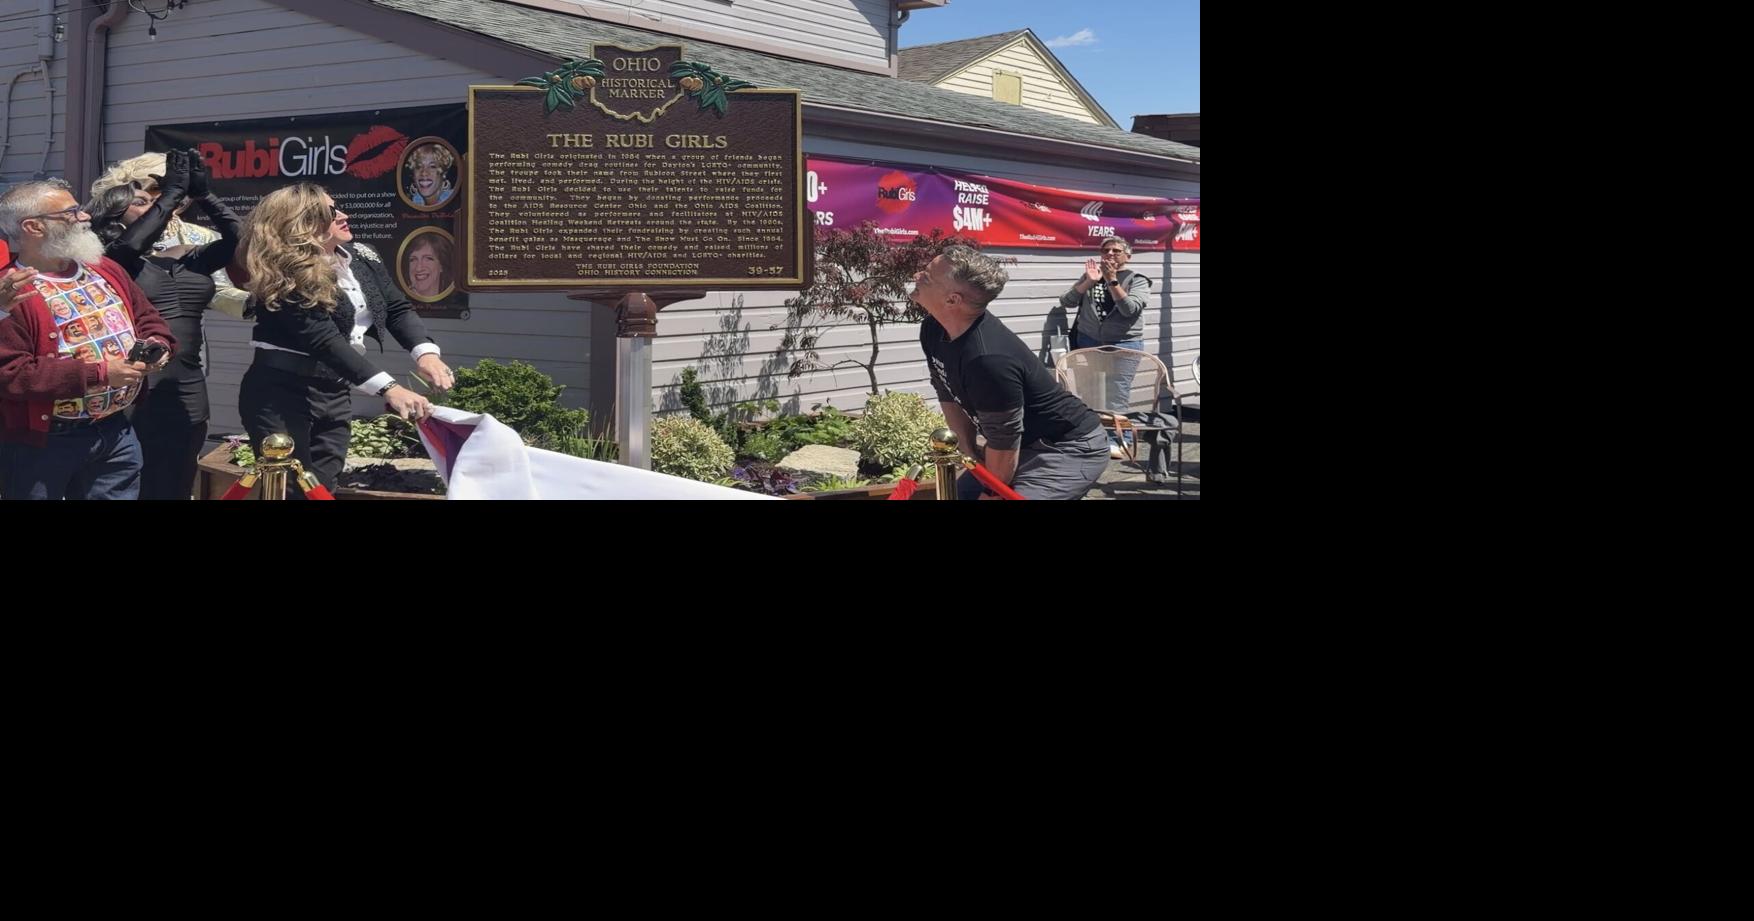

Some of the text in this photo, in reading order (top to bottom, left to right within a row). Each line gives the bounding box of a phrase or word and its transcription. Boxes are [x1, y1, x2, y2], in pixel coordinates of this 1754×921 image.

[613, 58, 661, 72] OHIO
[601, 78, 675, 88] HISTORICAL
[609, 89, 666, 98] MARKER
[547, 134, 728, 148] THE RUBI GIRLS
[199, 136, 348, 178] RubiGirls
[807, 170, 828, 202] 0+
[958, 192, 989, 205] RAISE
[952, 204, 992, 232] $4M+
[1088, 225, 1115, 237] YEARS
